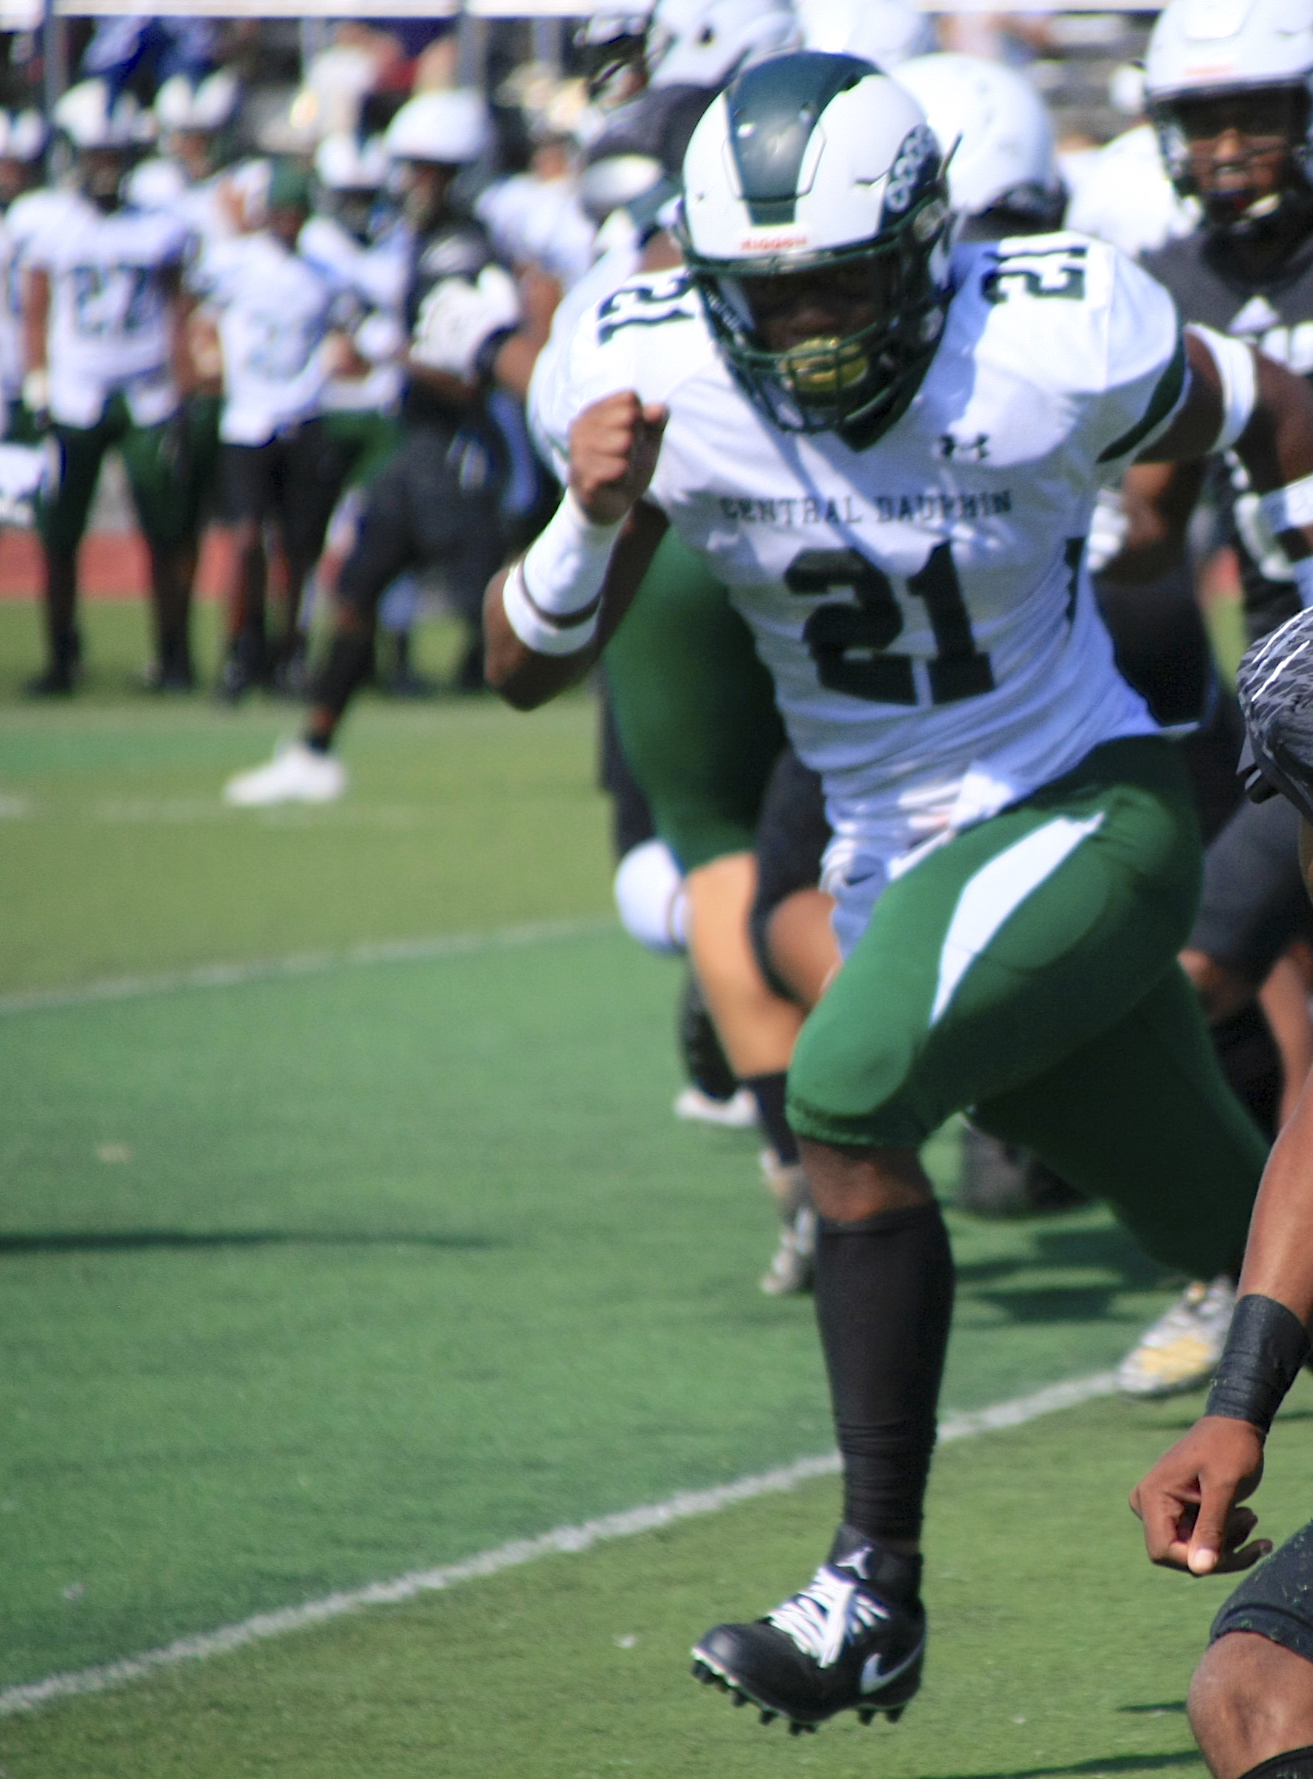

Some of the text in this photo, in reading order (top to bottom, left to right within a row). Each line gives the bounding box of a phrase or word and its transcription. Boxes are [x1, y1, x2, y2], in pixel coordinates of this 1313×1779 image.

[720, 488, 1012, 526] CENTRAL DAUPHIN
[784, 538, 996, 706] 21
